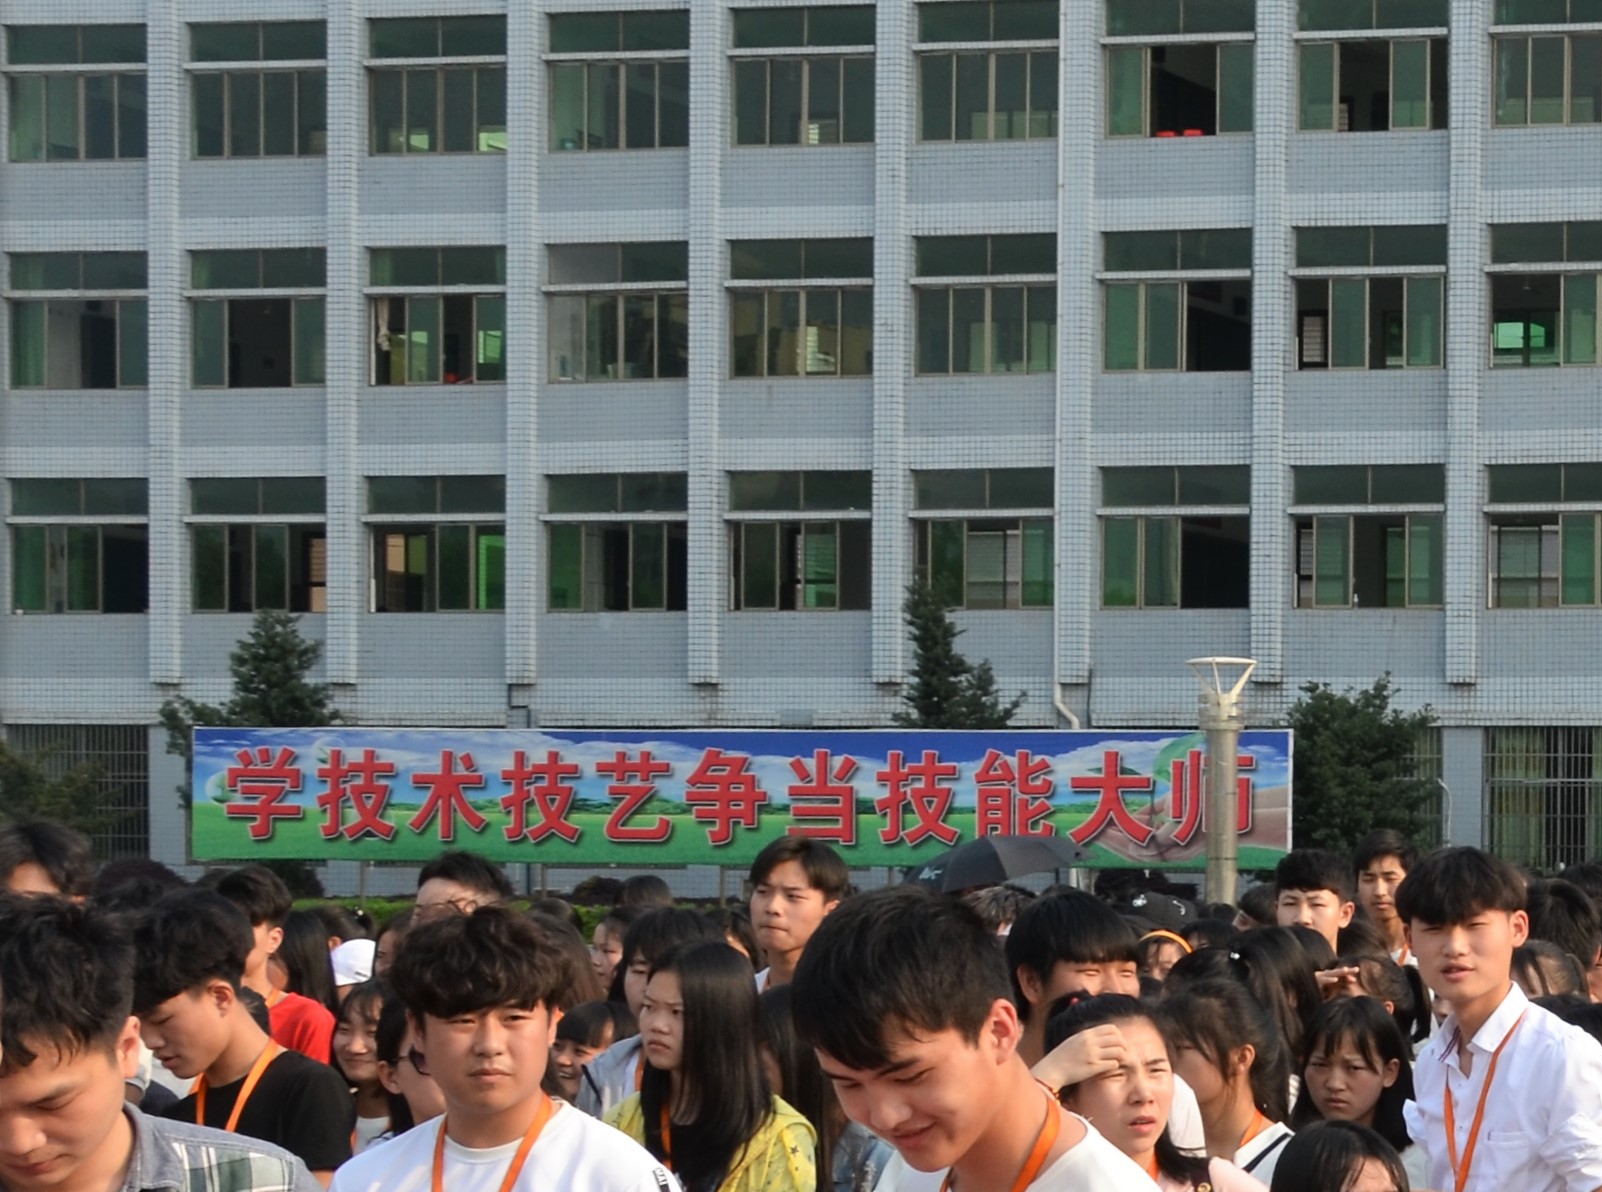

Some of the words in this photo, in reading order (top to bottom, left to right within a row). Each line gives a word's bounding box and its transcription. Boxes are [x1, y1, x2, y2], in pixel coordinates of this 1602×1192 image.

[225, 746, 1256, 846] 学技术技艺争当技能大师
